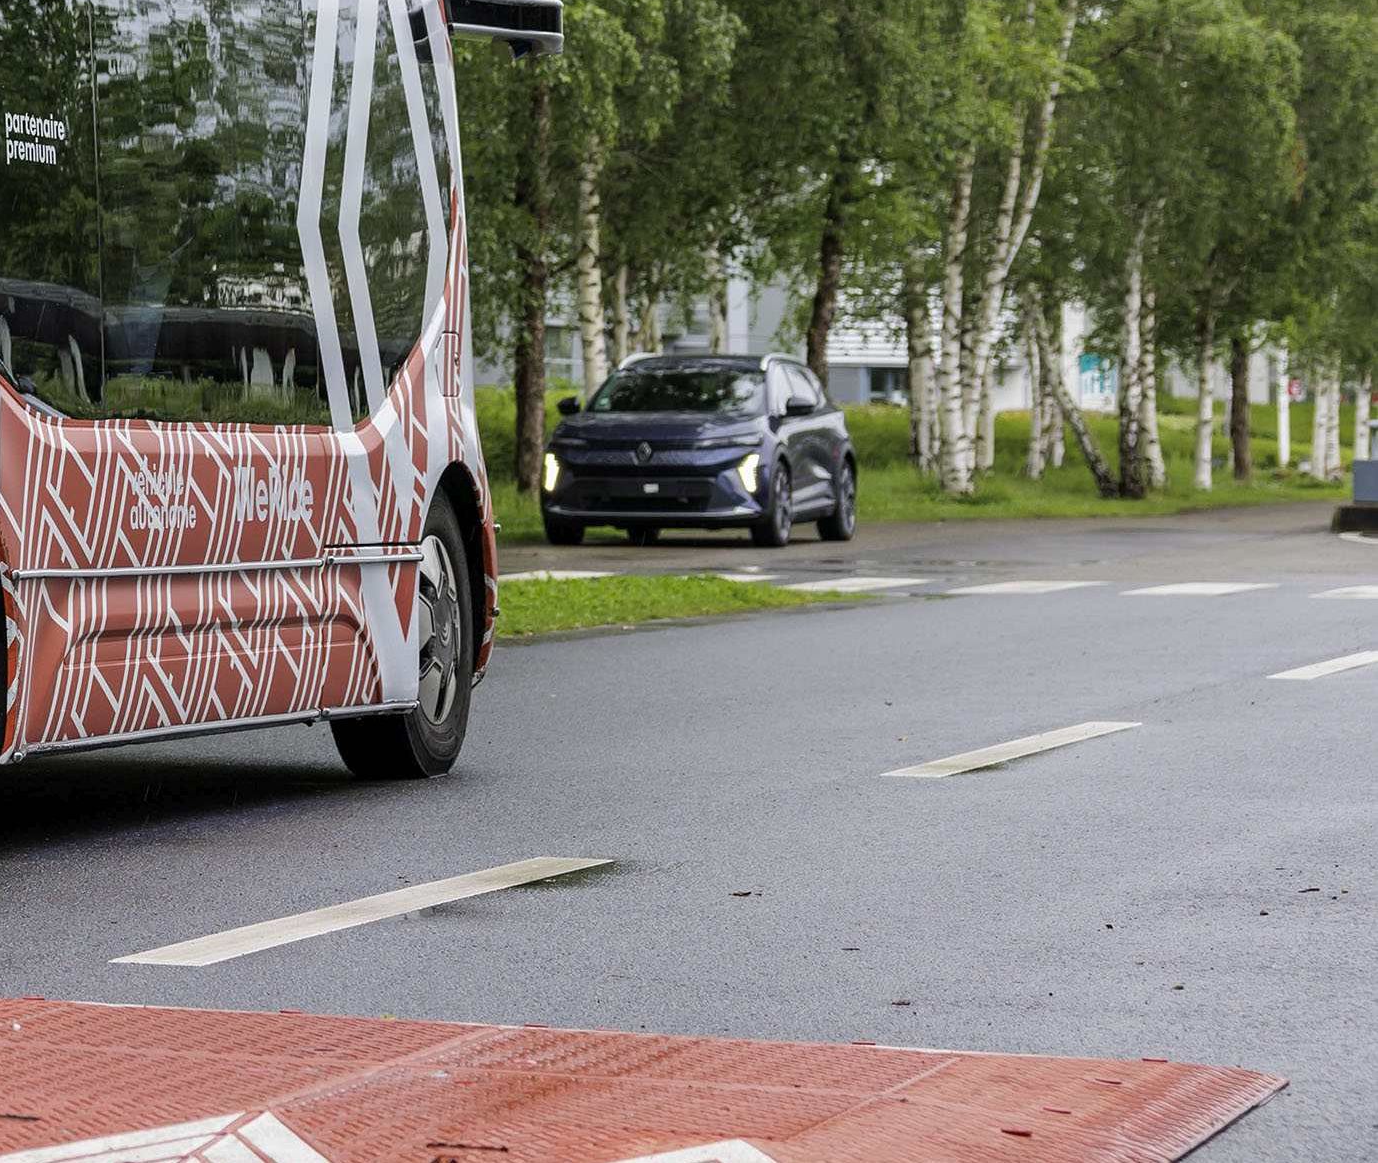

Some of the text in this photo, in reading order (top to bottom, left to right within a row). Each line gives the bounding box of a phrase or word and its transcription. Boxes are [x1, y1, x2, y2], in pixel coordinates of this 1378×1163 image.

[5, 112, 66, 140] partenaire
[6, 138, 57, 165] premium
[233, 465, 313, 521] WeRide
